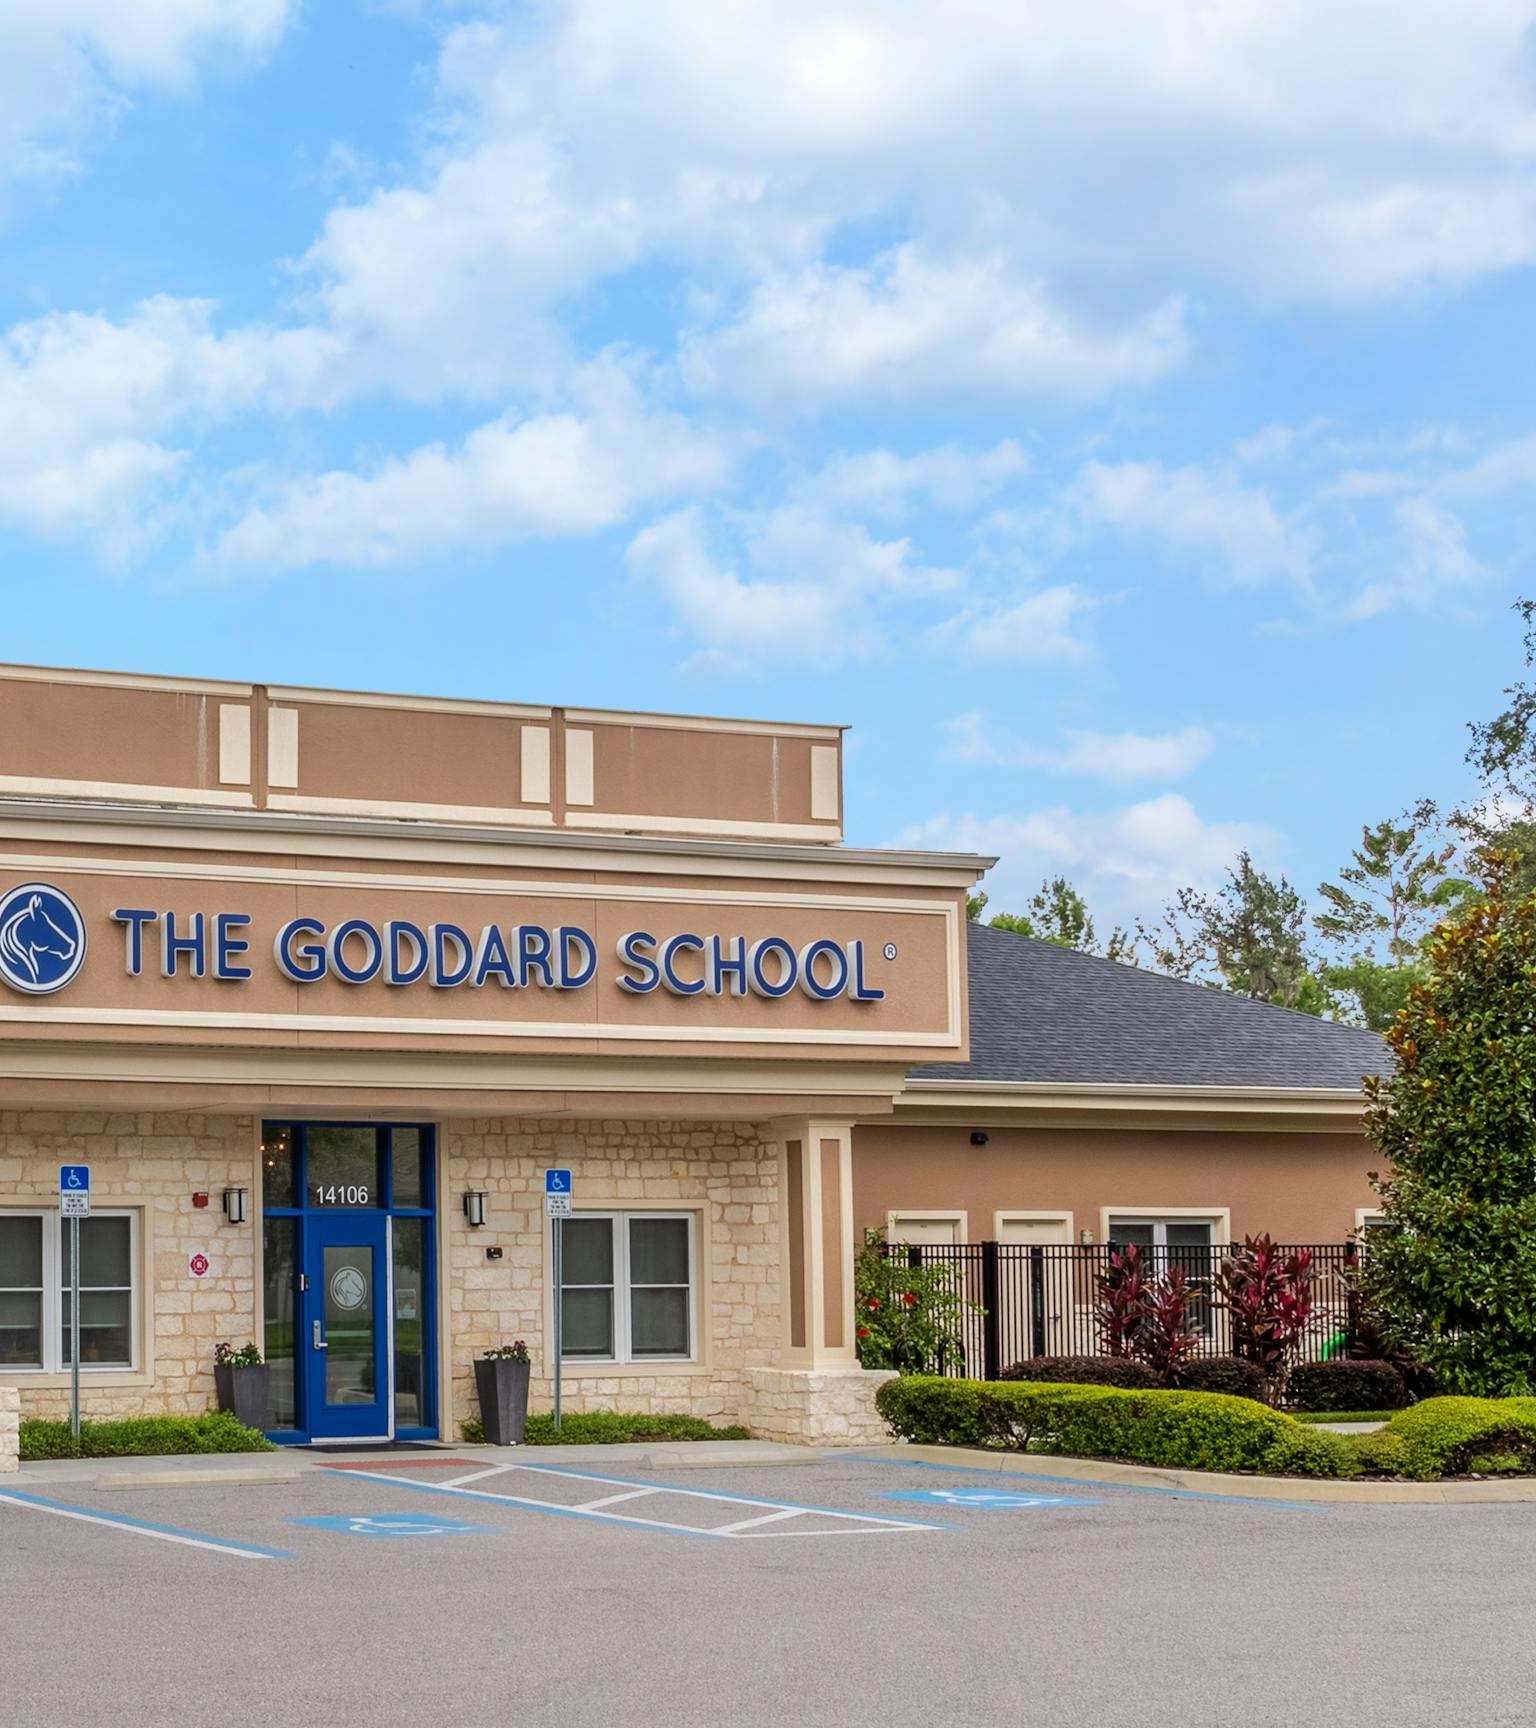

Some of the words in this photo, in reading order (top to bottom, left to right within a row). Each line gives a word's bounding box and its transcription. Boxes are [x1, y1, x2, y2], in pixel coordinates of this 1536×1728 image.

[110, 907, 253, 980] THE
[274, 917, 598, 989] GODDARD
[615, 931, 886, 1000] SCHOOL
[316, 1185, 369, 1205] 14106
